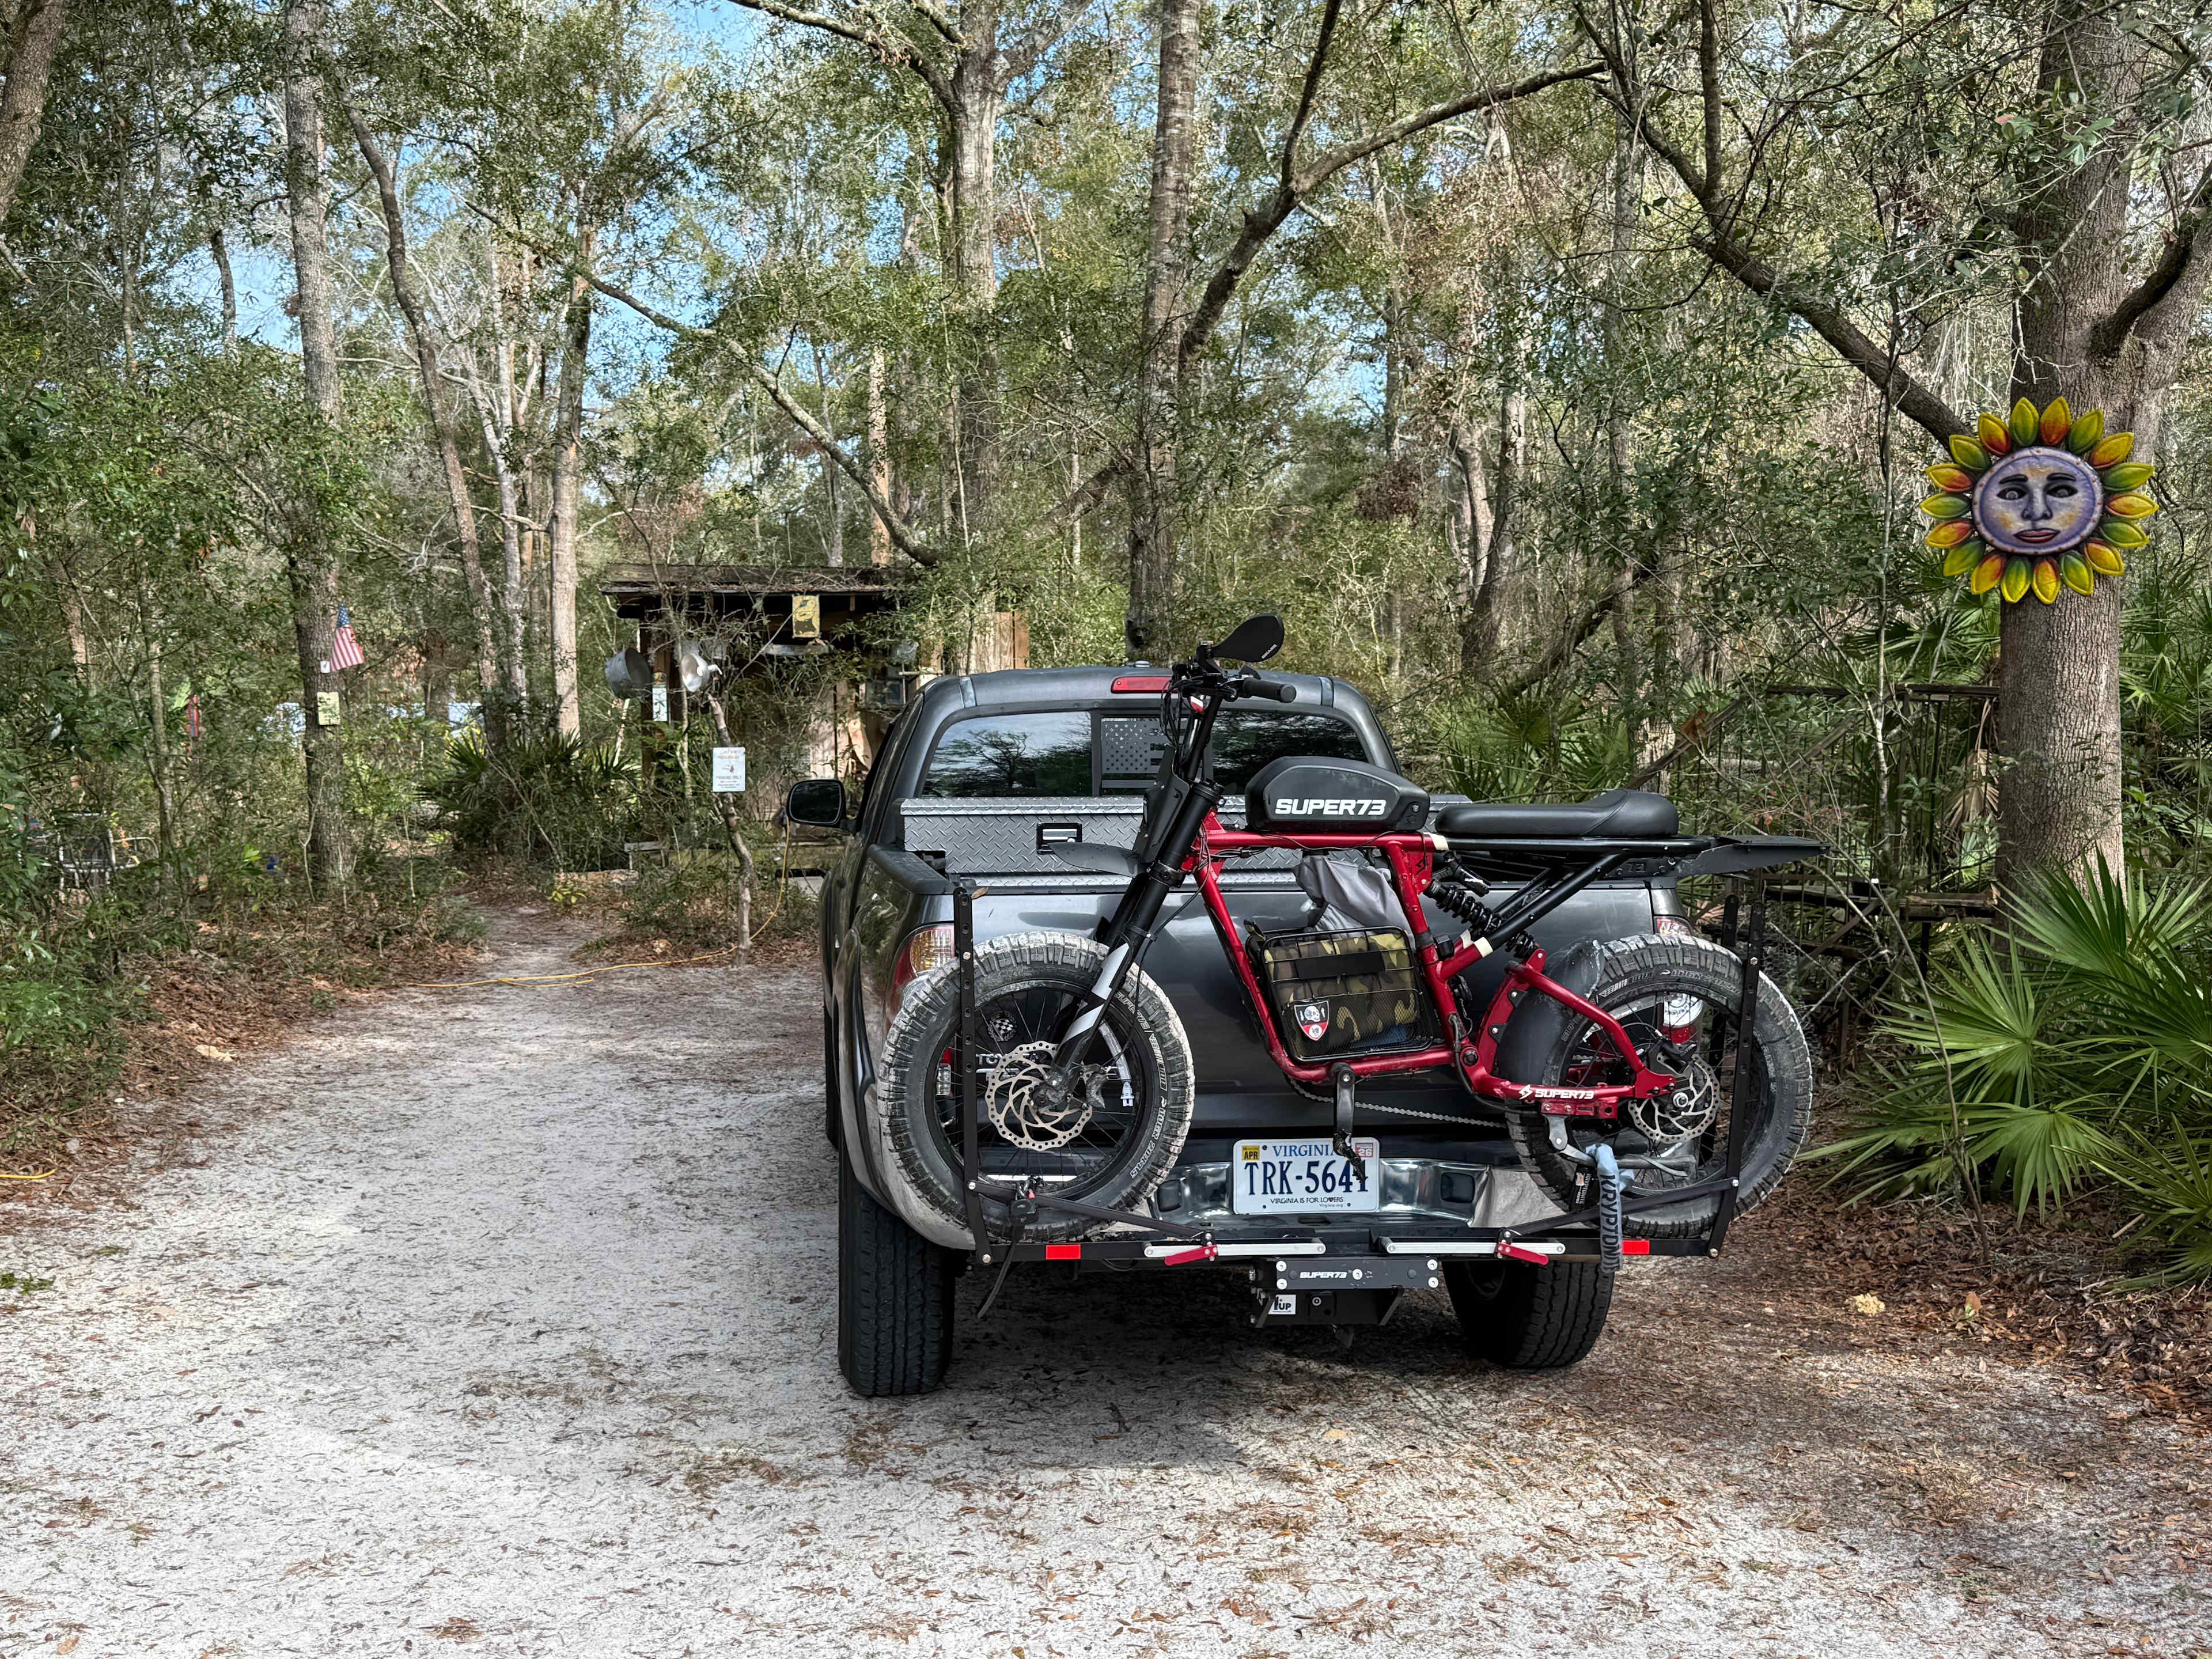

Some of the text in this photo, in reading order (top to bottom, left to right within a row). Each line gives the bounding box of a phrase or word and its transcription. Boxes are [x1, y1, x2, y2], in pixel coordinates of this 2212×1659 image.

[1275, 798, 1387, 815] SUPER73
[1535, 1089, 1595, 1100] SUPER73
[1244, 1151, 1258, 1160] APR
[1244, 1160, 1368, 1195] TRK-5641
